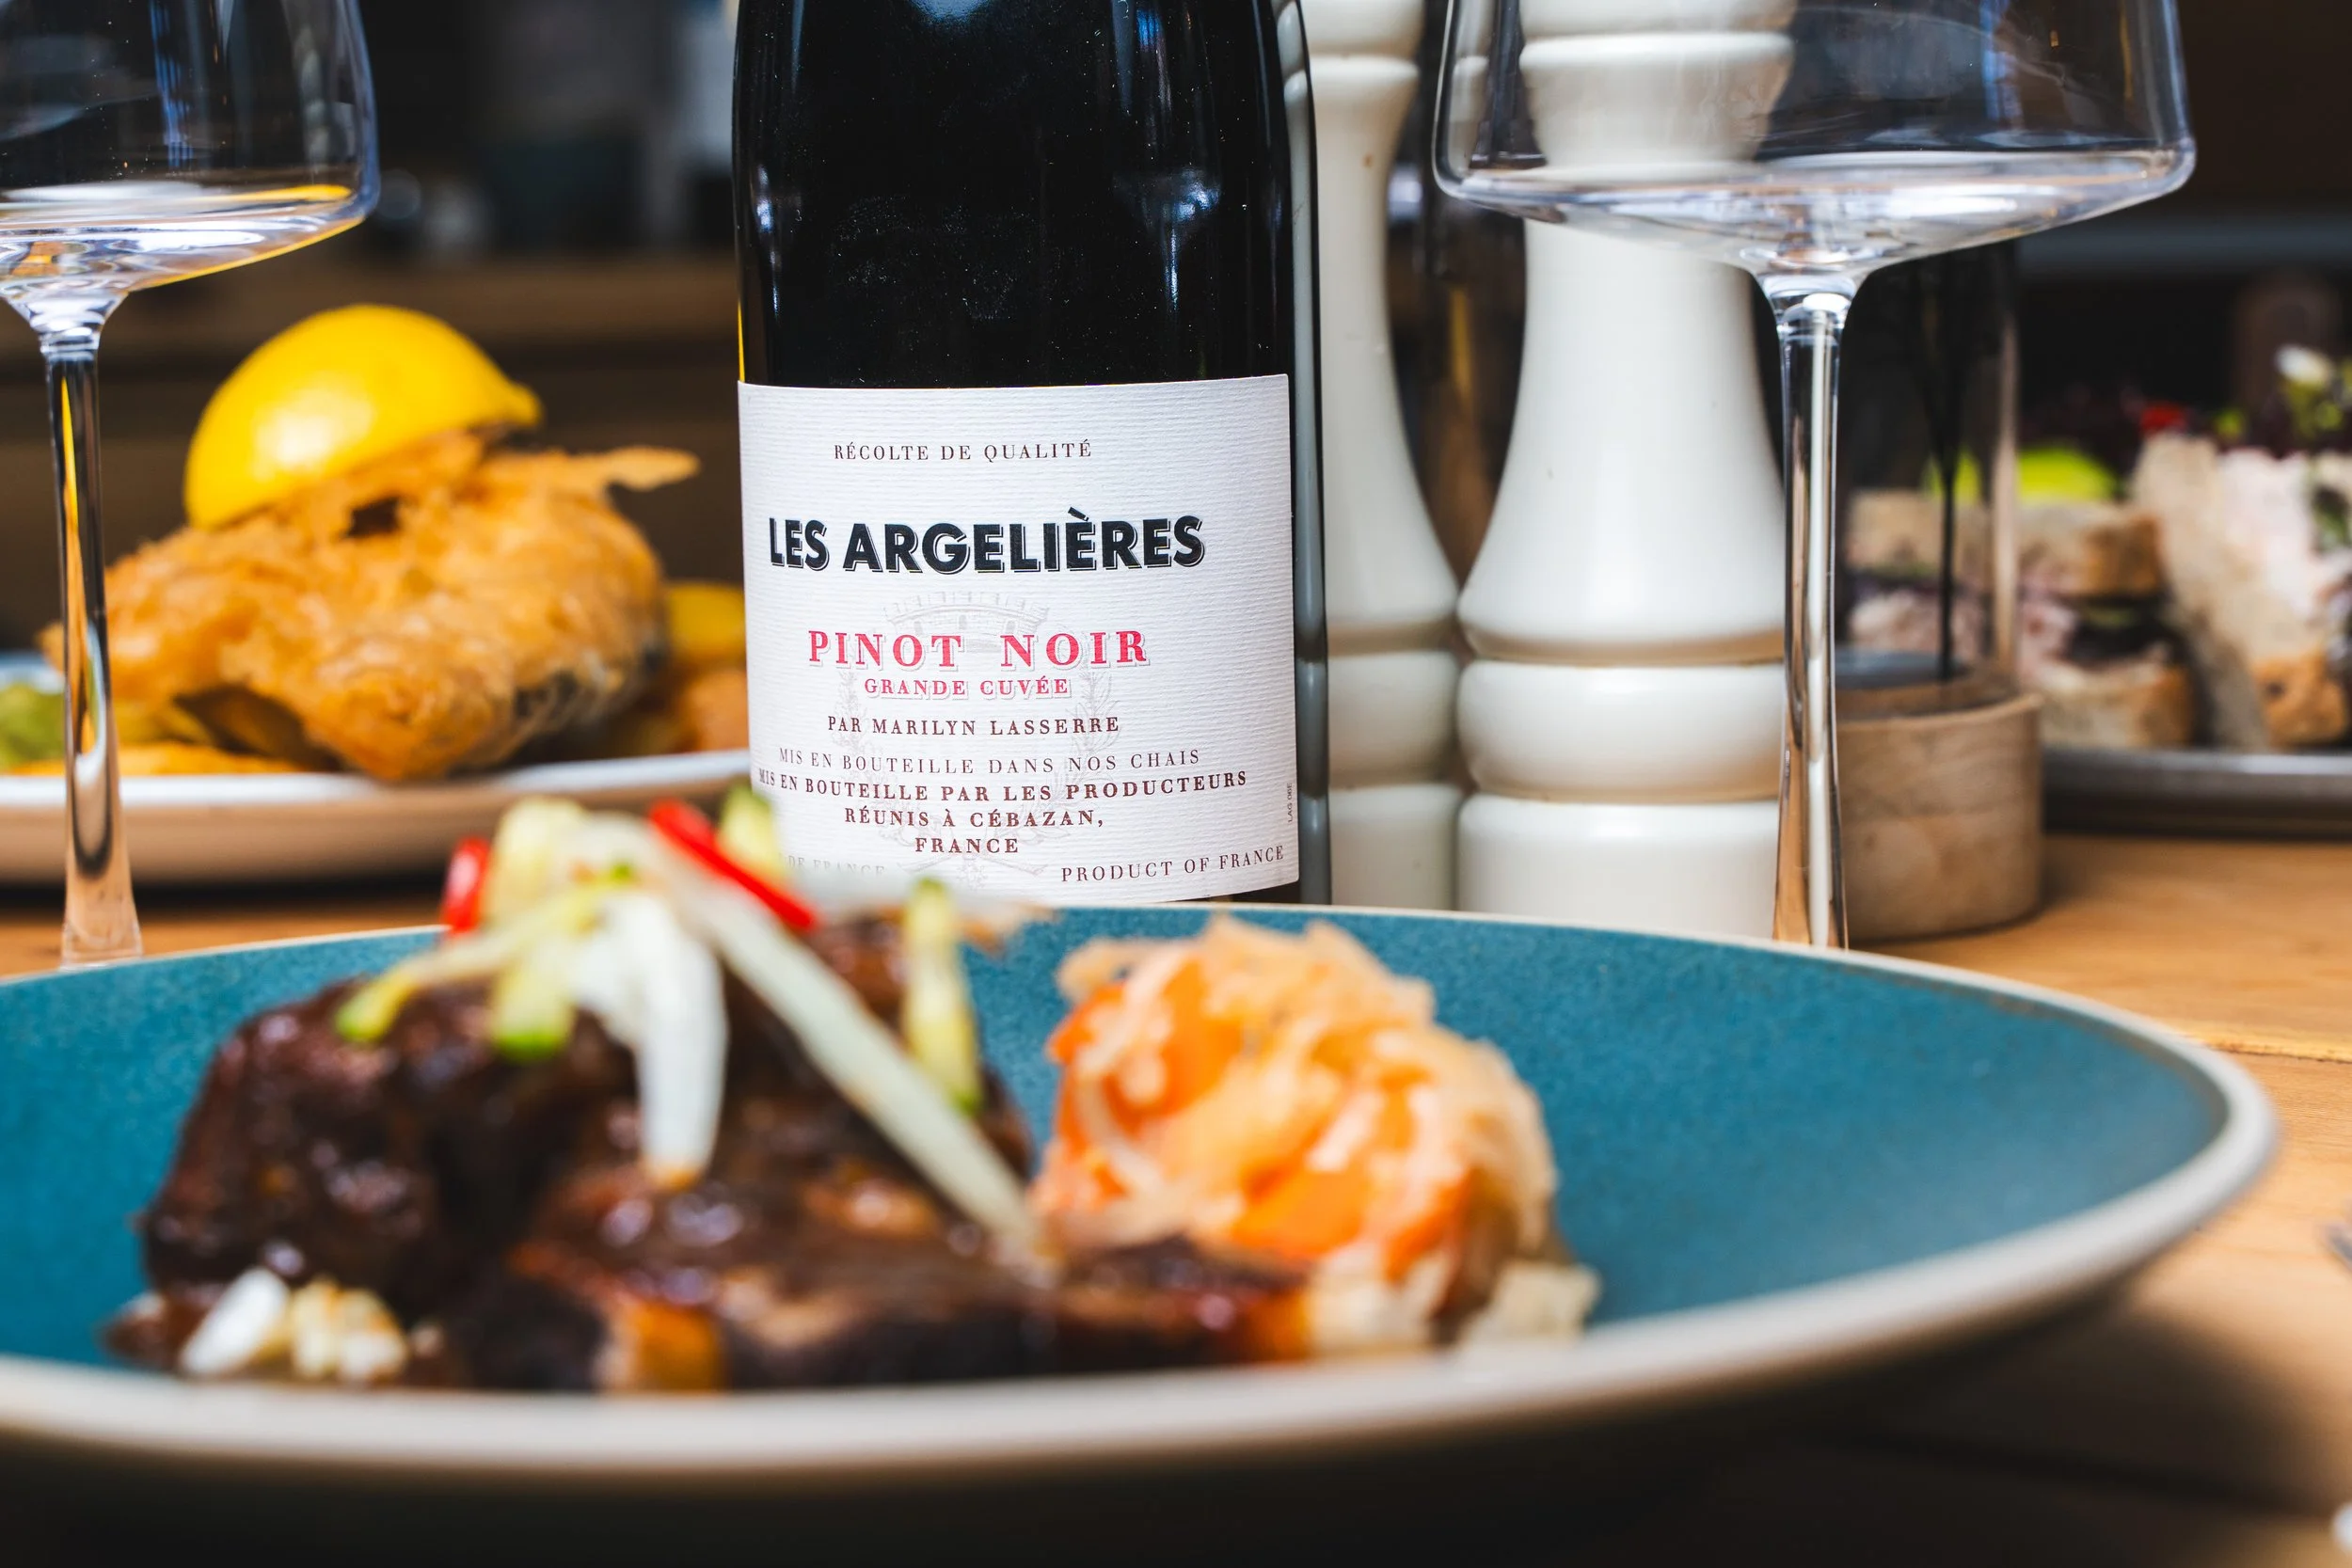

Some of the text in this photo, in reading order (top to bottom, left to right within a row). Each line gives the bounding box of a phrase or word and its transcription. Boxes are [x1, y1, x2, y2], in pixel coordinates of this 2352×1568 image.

[834, 439, 1091, 463] RÉCOLTE DE QUALITÉ
[770, 507, 1205, 575] LES ARGELIÈRES
[809, 630, 1149, 668] PINOT NOIR
[865, 675, 1068, 695] GRANDE CUVÉE
[828, 716, 1119, 736] PAR MARILYN LASSERRE
[780, 748, 1200, 774] MIS EN BOUTEILLE DANS NOS CHAIS
[759, 768, 1247, 801] MIS EN BOUTEILLE PAR LES PRODUCTEURS
[845, 806, 1104, 828] RÉUNIS À CÉBAZAN,
[915, 837, 1018, 853] FRANCE
[1062, 846, 1283, 881] PRODUCT OF FRANCE
